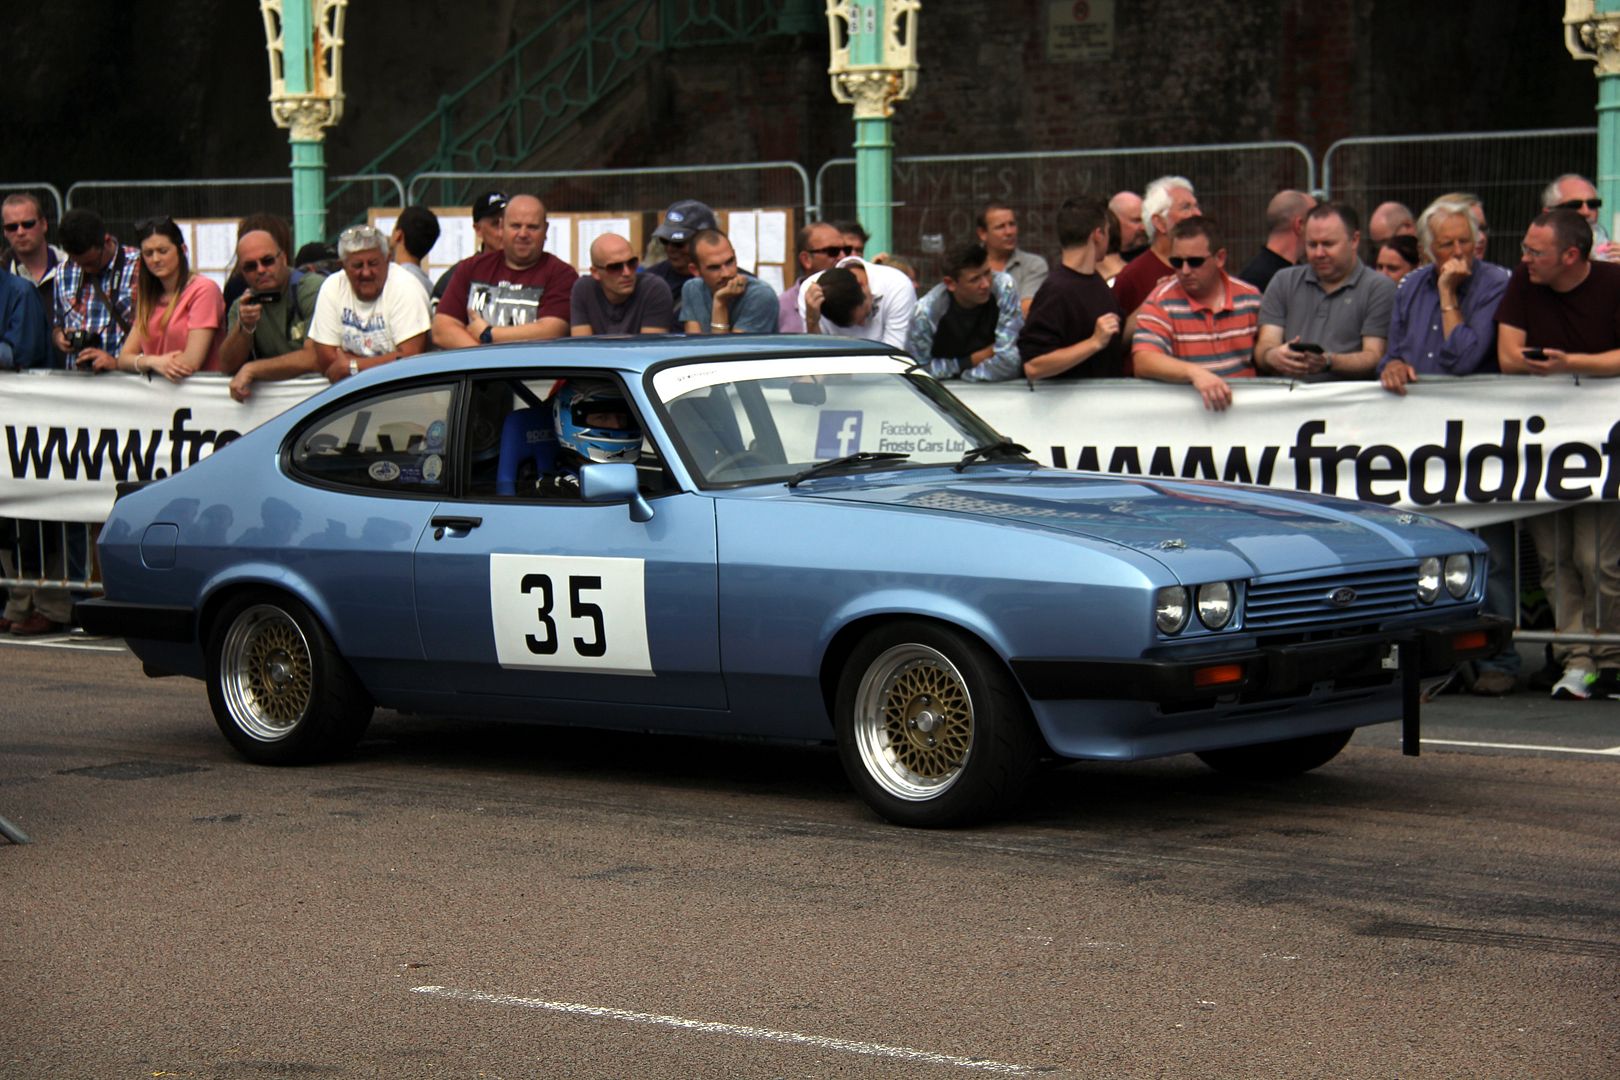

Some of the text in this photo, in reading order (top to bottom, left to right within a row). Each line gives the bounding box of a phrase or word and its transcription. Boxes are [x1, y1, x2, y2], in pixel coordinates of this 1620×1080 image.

[880, 421, 932, 436] Facebook
[879, 438, 965, 453] Frosts Cars Ltd
[520, 573, 607, 657] 35
